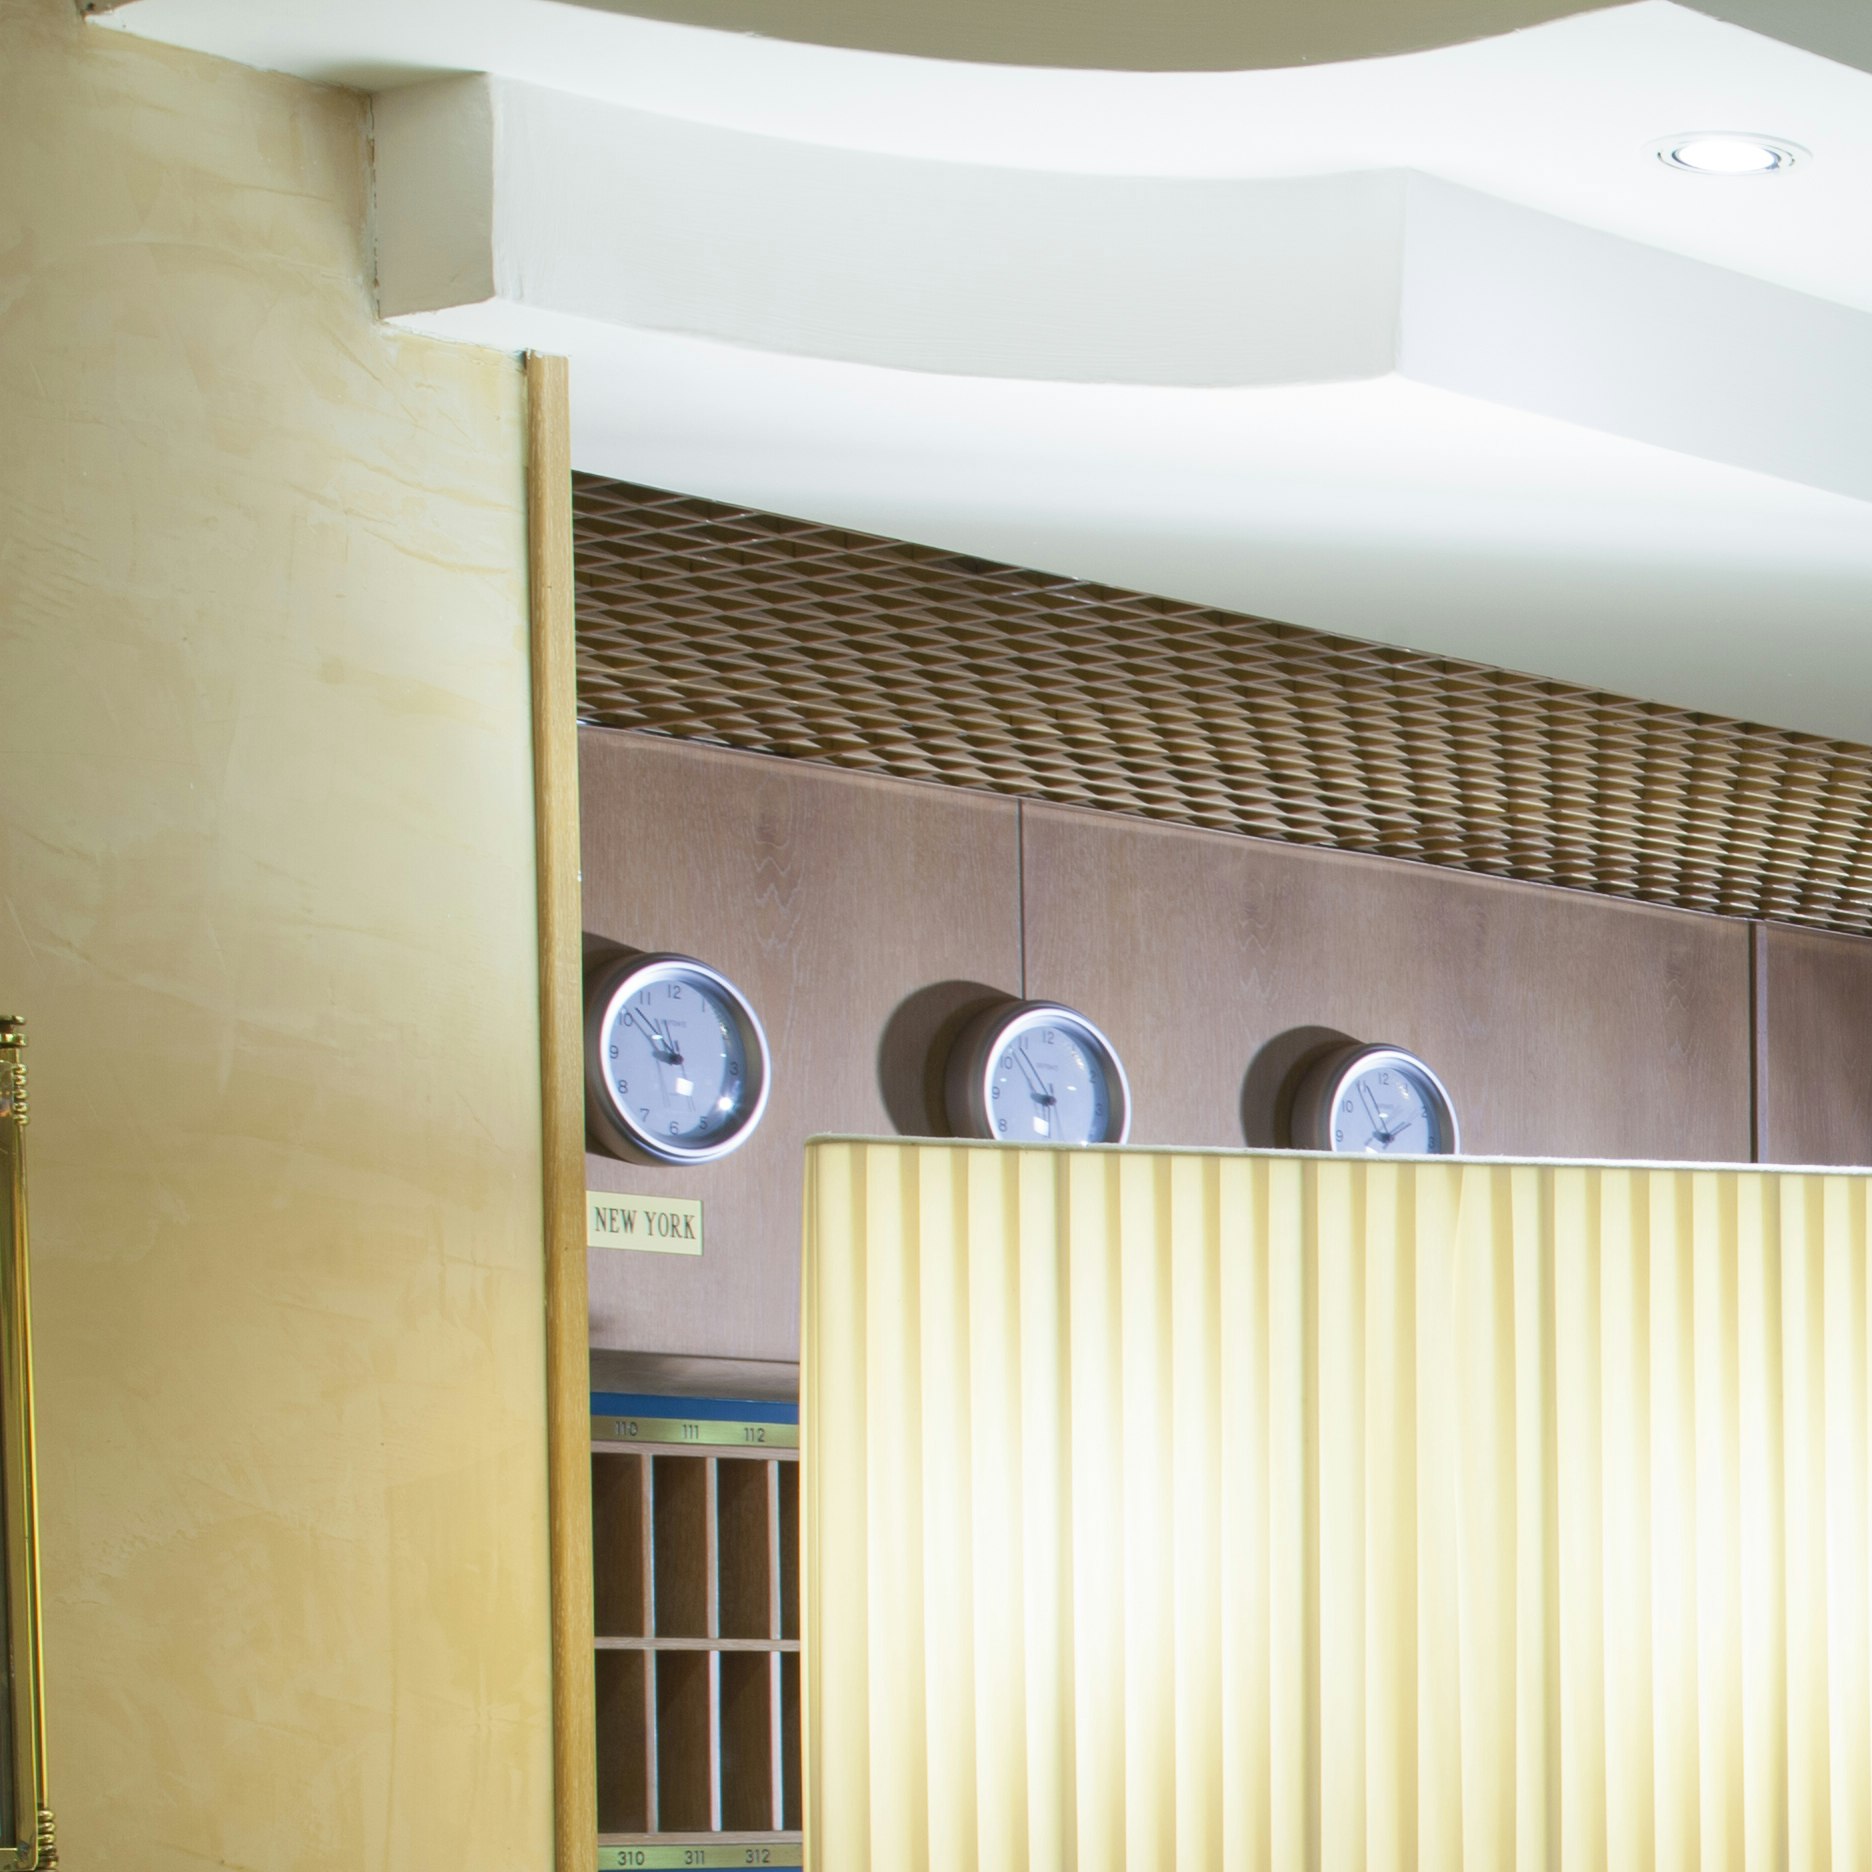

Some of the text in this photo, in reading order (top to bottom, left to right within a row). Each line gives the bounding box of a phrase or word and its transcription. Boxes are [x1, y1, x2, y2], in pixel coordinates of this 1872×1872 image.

[640, 991, 651, 1005] 11
[667, 984, 681, 999] 12
[1042, 1031, 1054, 1044] 12
[610, 1045, 619, 1059] 9
[1000, 1055, 1013, 1070] 10
[1378, 1073, 1389, 1085] 12
[618, 1080, 628, 1094] 8
[992, 1086, 1000, 1099] 9
[1342, 1100, 1353, 1113] 10
[640, 1108, 650, 1122] 7
[670, 1121, 679, 1135] 6
[999, 1119, 1007, 1132] 8
[1336, 1130, 1344, 1142] 9
[595, 1206, 696, 1240] NEW YORK
[616, 1421, 765, 1442] 110 111 112
[617, 1849, 770, 1866] 310 311 312
